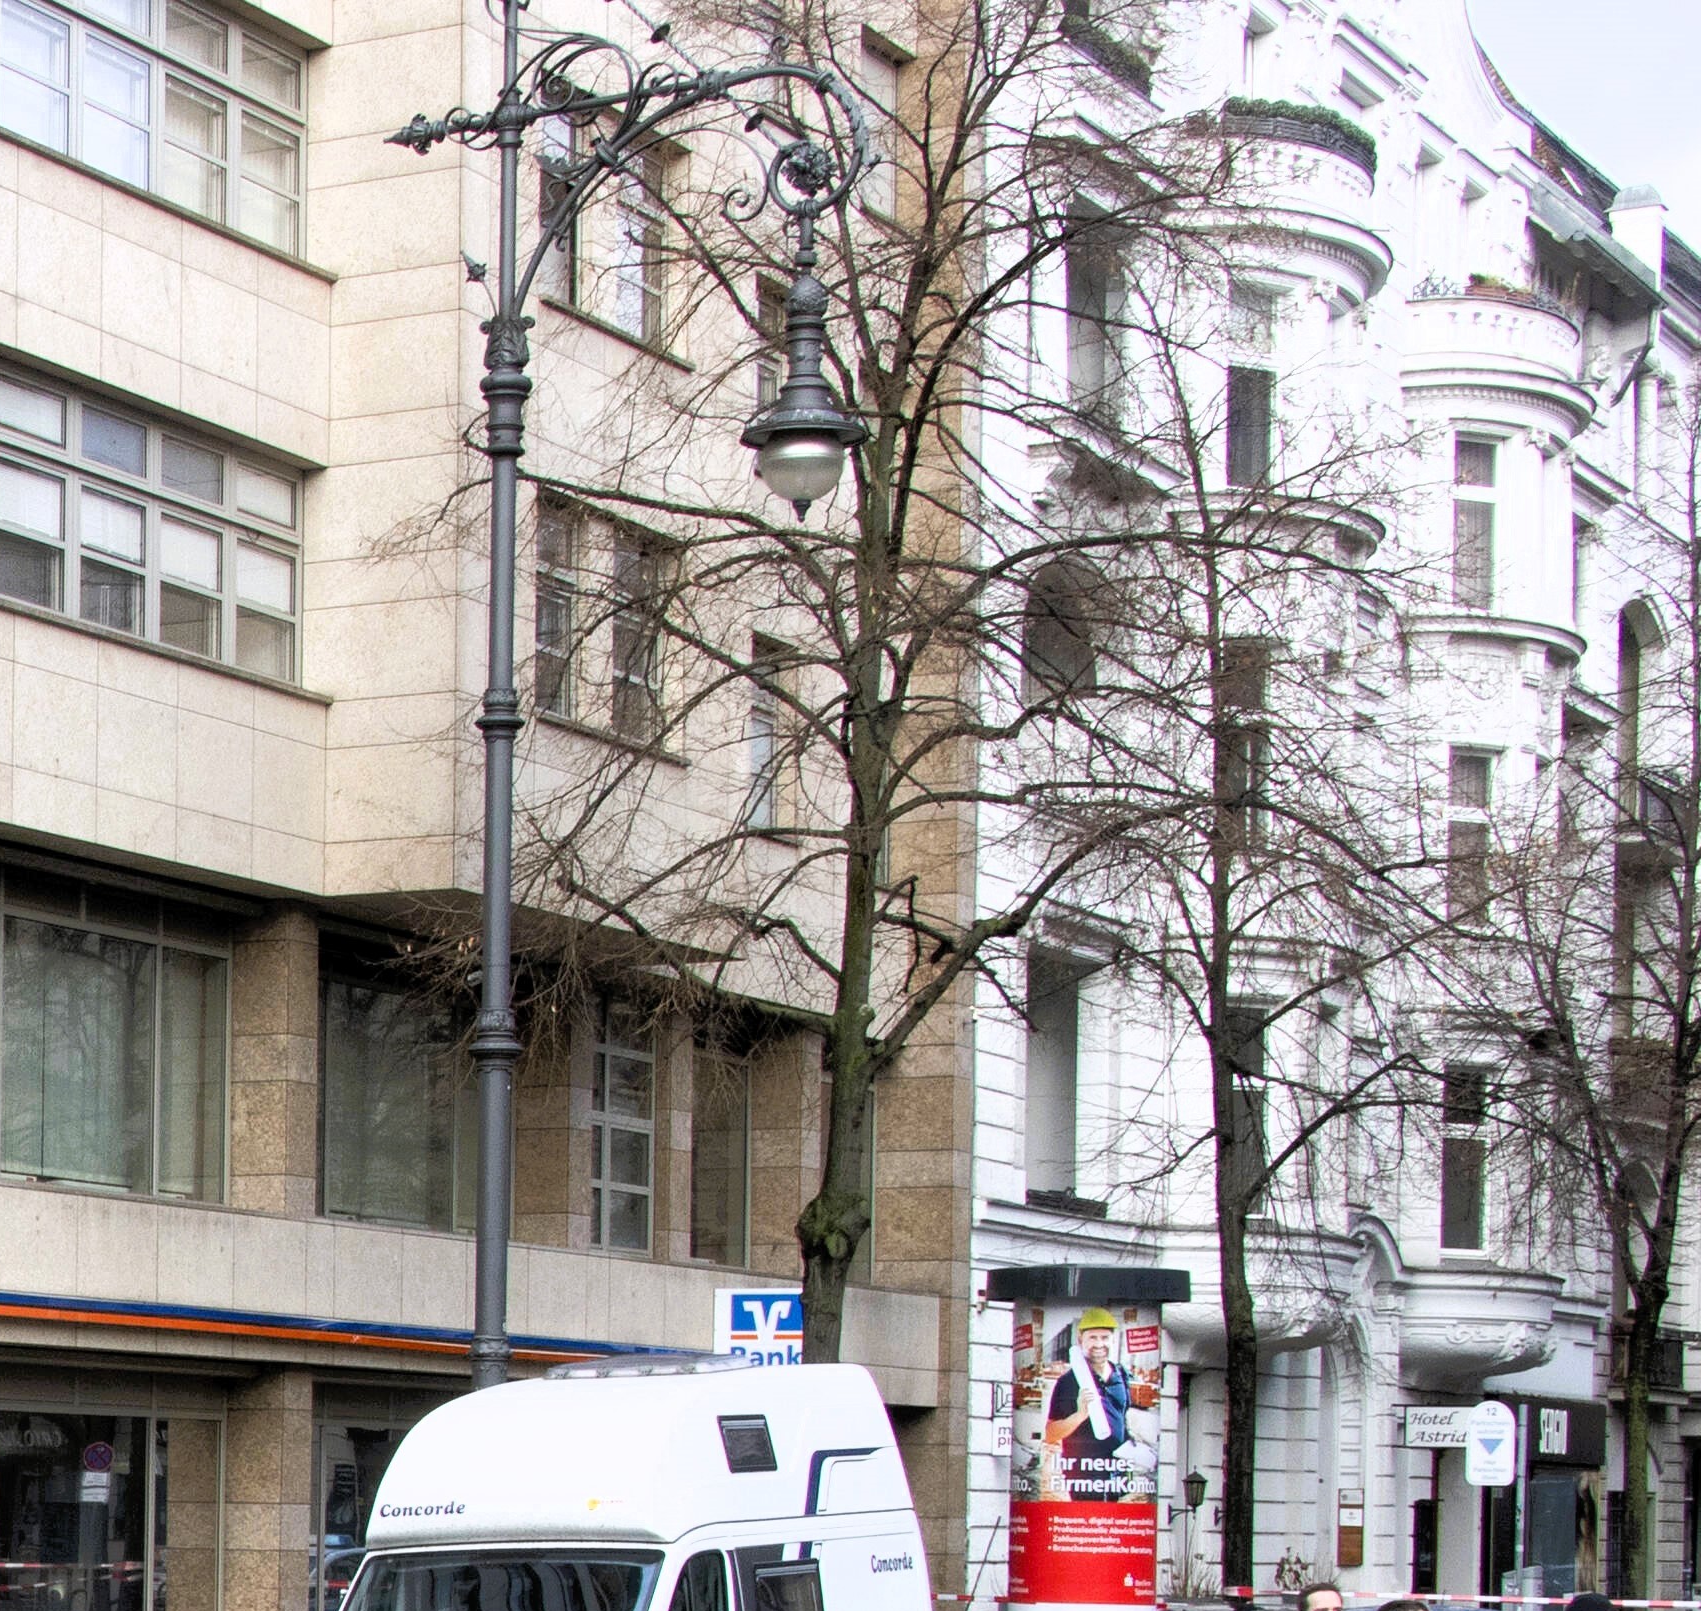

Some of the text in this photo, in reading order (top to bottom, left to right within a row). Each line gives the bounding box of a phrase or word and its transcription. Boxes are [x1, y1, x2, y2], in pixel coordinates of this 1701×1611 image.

[1409, 1411, 1459, 1425] Hotel
[1486, 1407, 1497, 1417] 12
[1409, 1430, 1468, 1443] Astrid
[1051, 1456, 1135, 1471] Ihr neues
[380, 1501, 466, 1518] Concorde
[871, 1551, 913, 1573] Concorde
